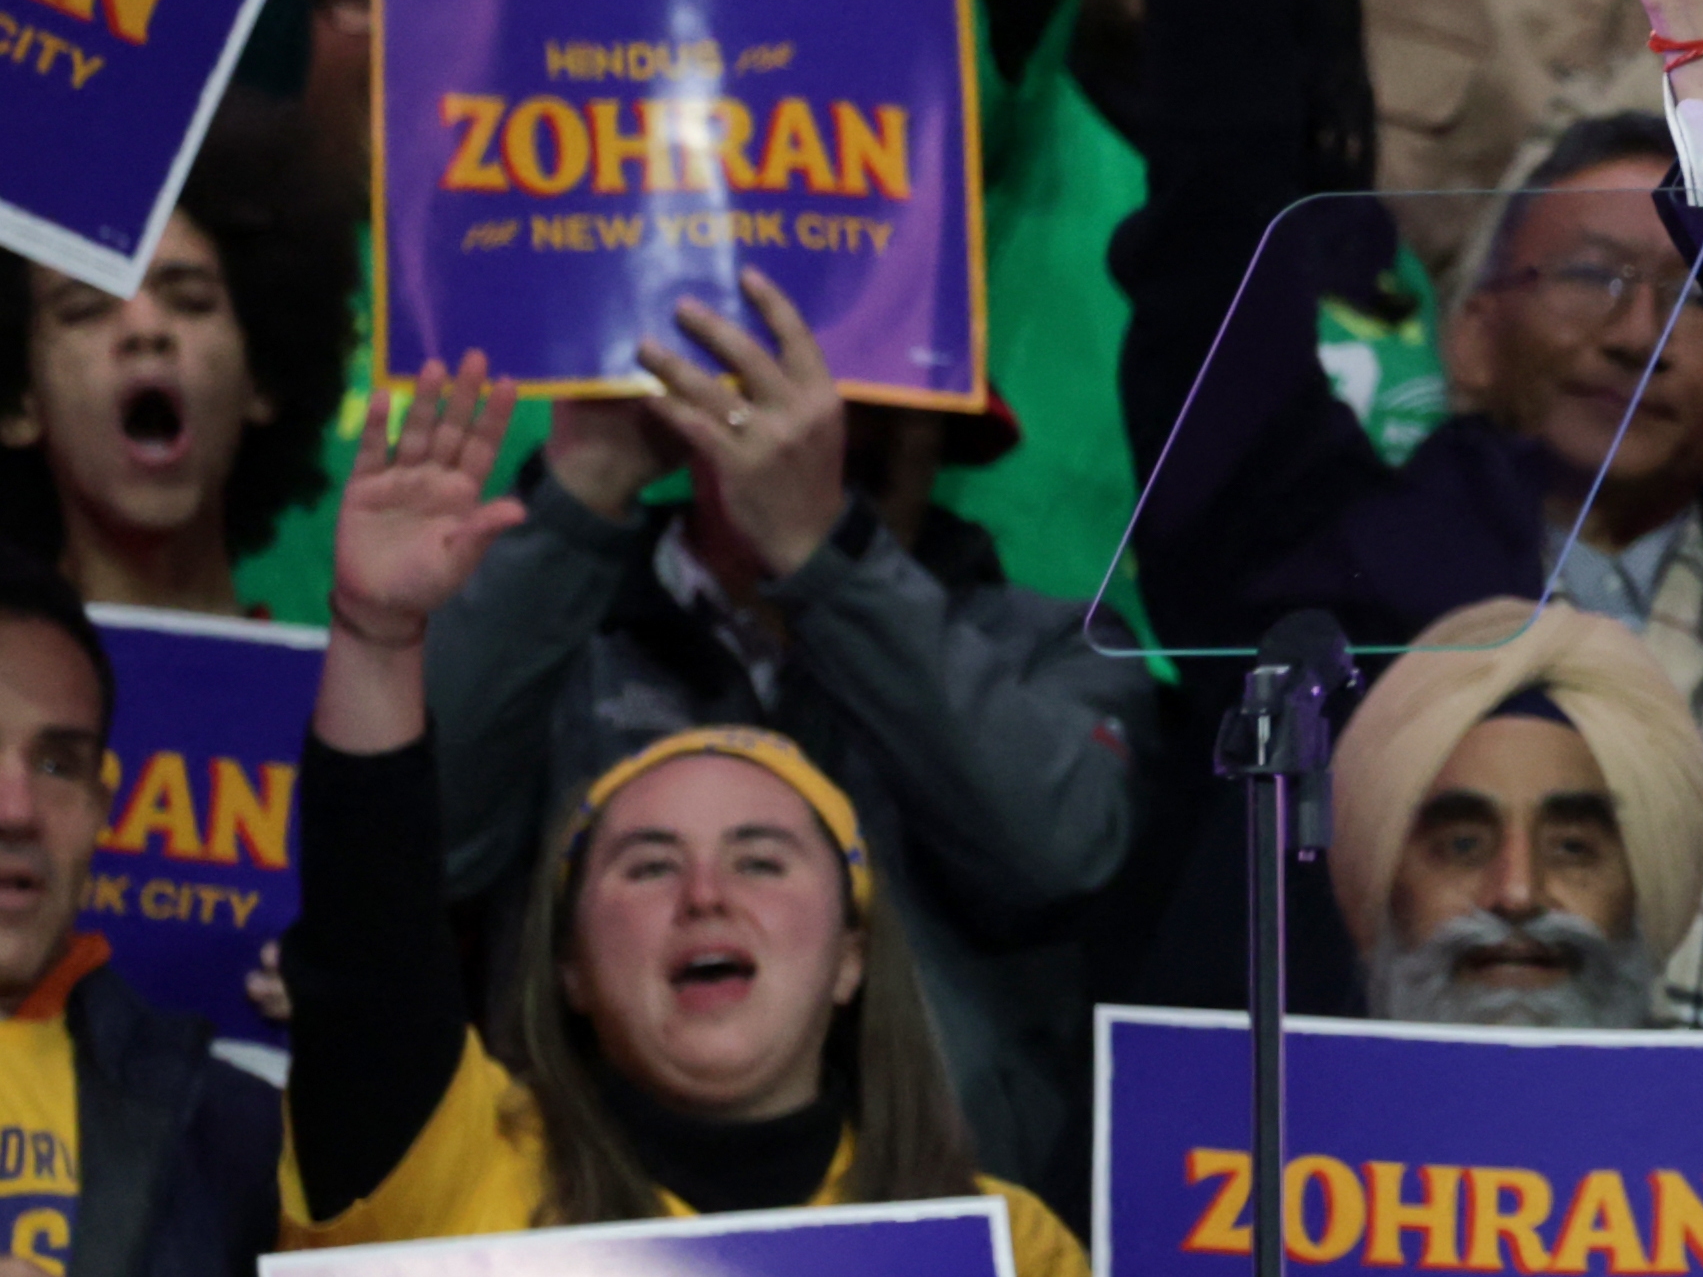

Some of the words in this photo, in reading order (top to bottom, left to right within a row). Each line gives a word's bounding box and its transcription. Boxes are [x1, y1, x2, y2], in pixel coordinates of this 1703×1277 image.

[543, 37, 725, 82] HINDUS
[437, 91, 912, 201] ZOHRAN
[529, 210, 645, 253] NEW
[655, 209, 790, 250] YORK
[793, 210, 895, 258] CITY
[95, 747, 300, 872] AN
[138, 876, 262, 931] CITY
